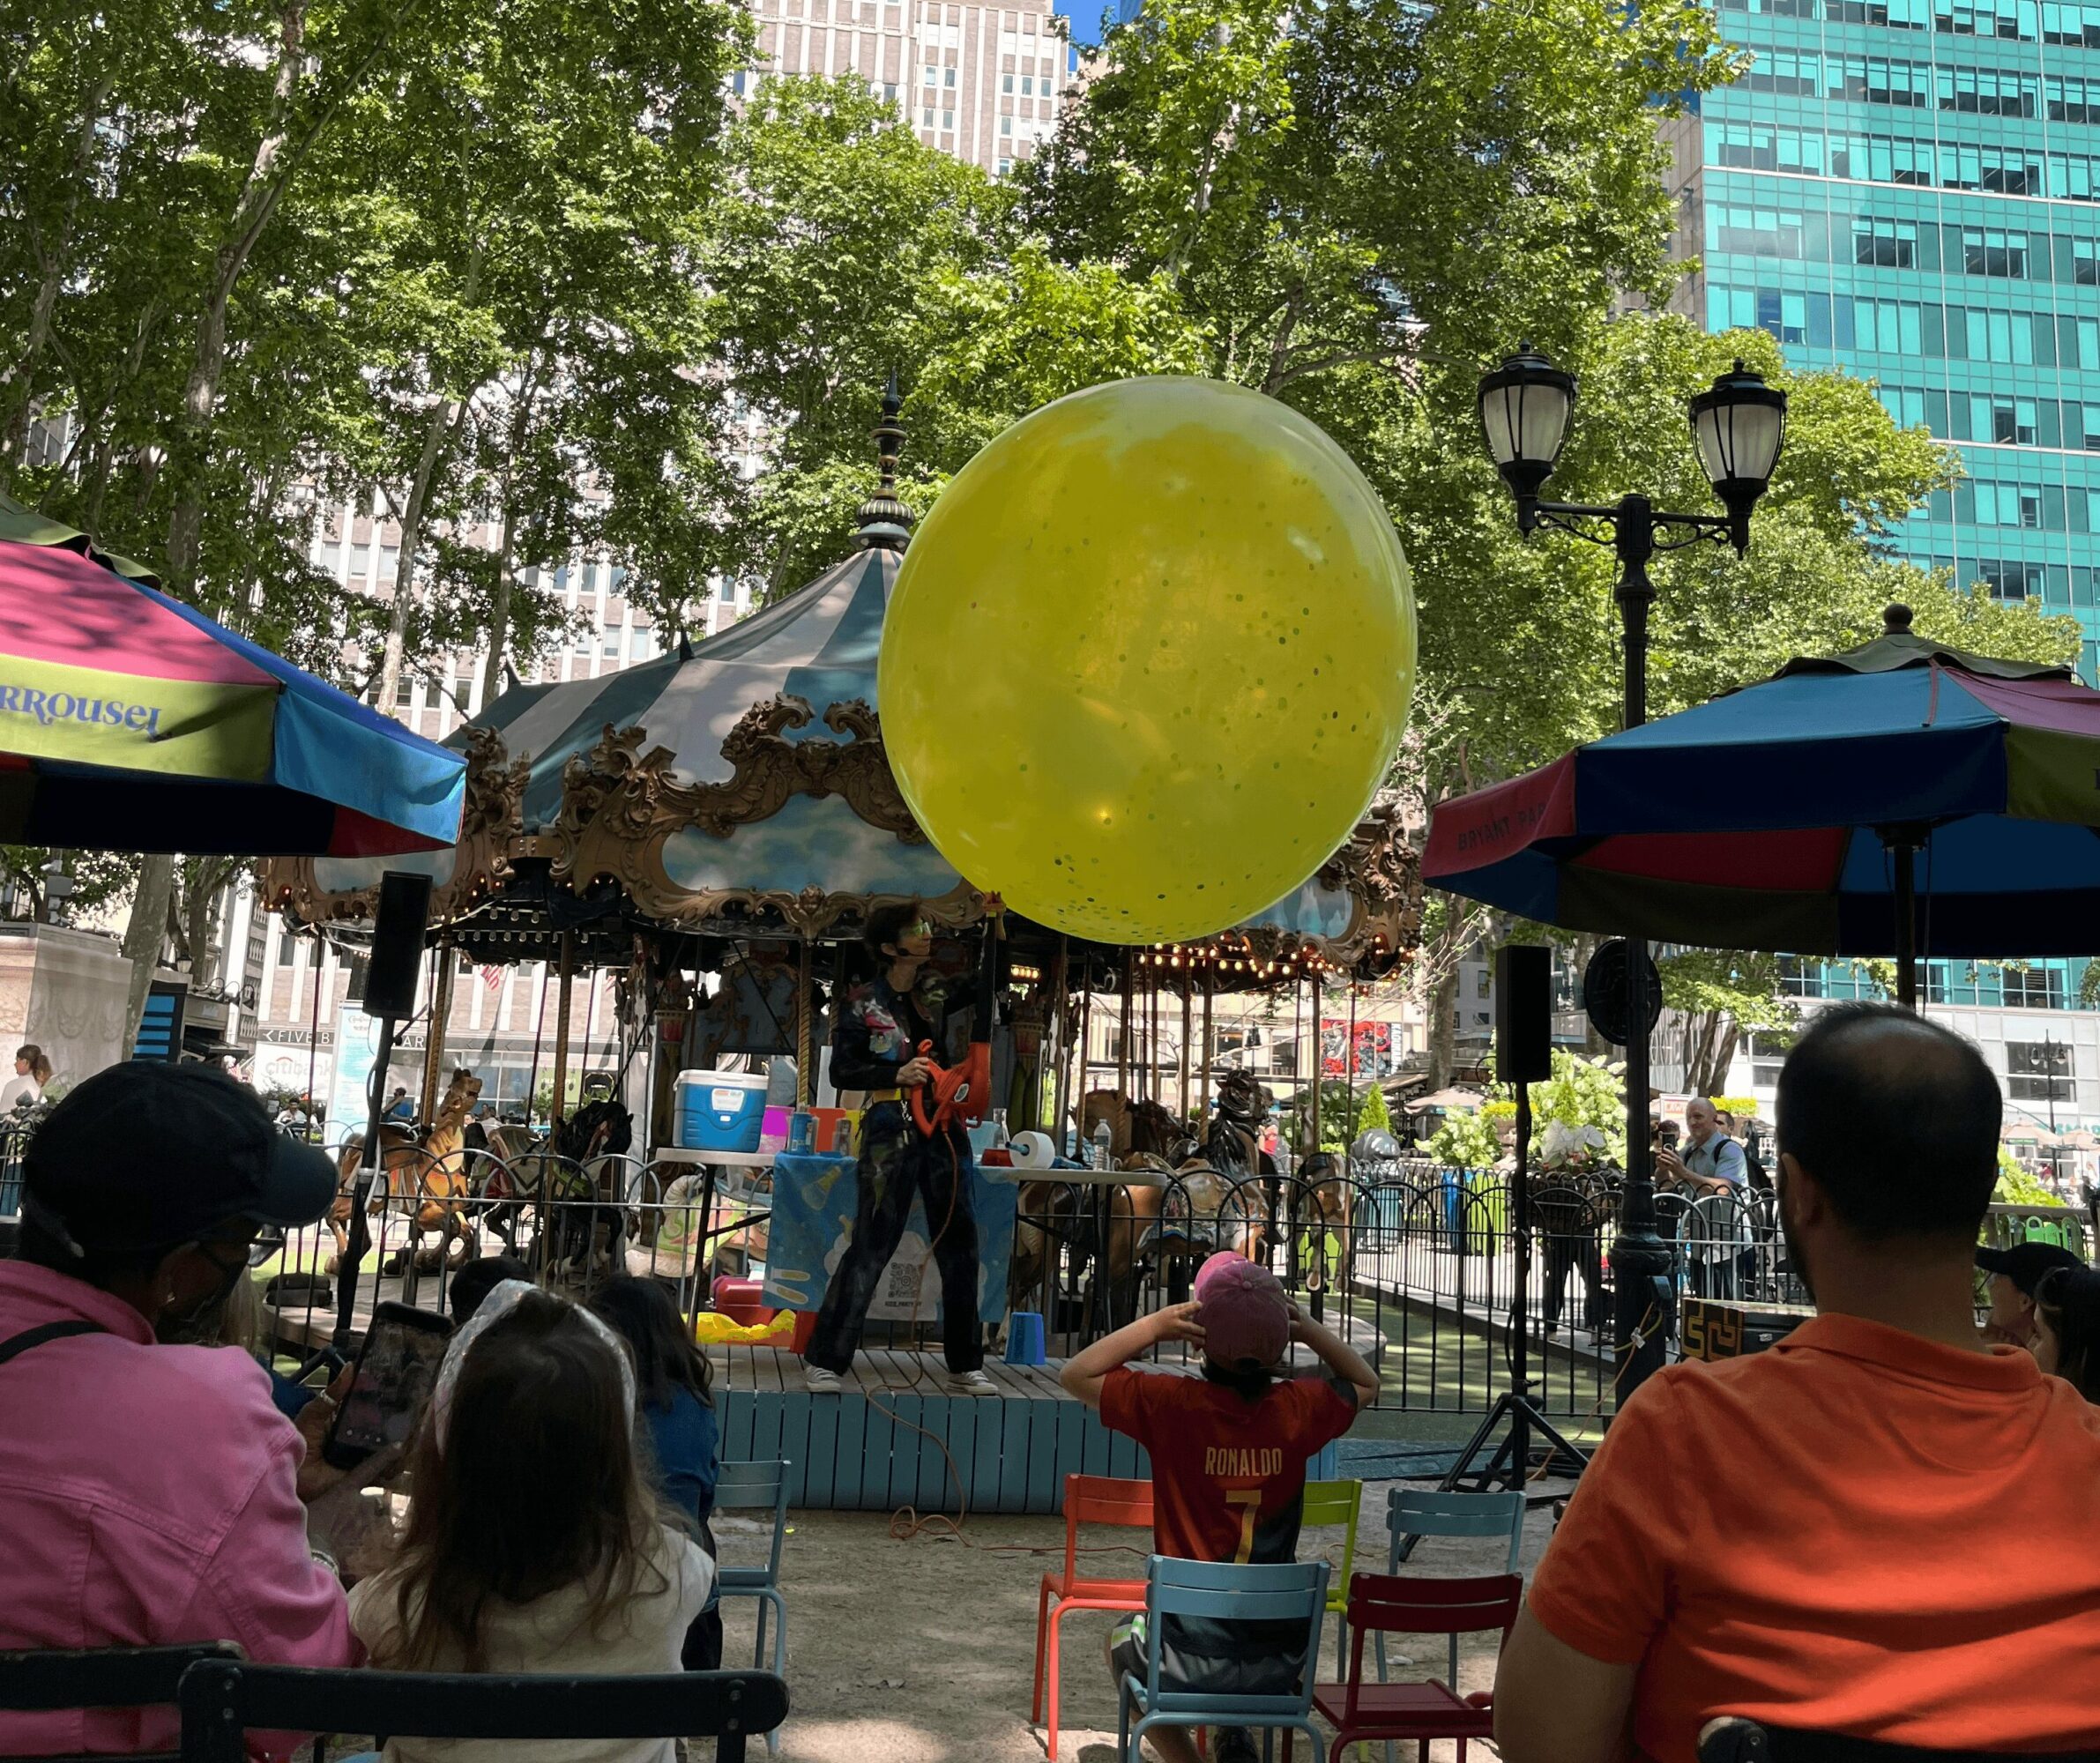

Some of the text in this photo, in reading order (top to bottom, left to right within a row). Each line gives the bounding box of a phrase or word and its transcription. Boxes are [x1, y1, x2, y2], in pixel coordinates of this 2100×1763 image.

[1457, 803, 1546, 852] BRYANT PAR
[277, 1030, 312, 1044] FIVE
[1204, 1447, 1283, 1477] RONALDO
[1225, 1490, 1262, 1564] 7
